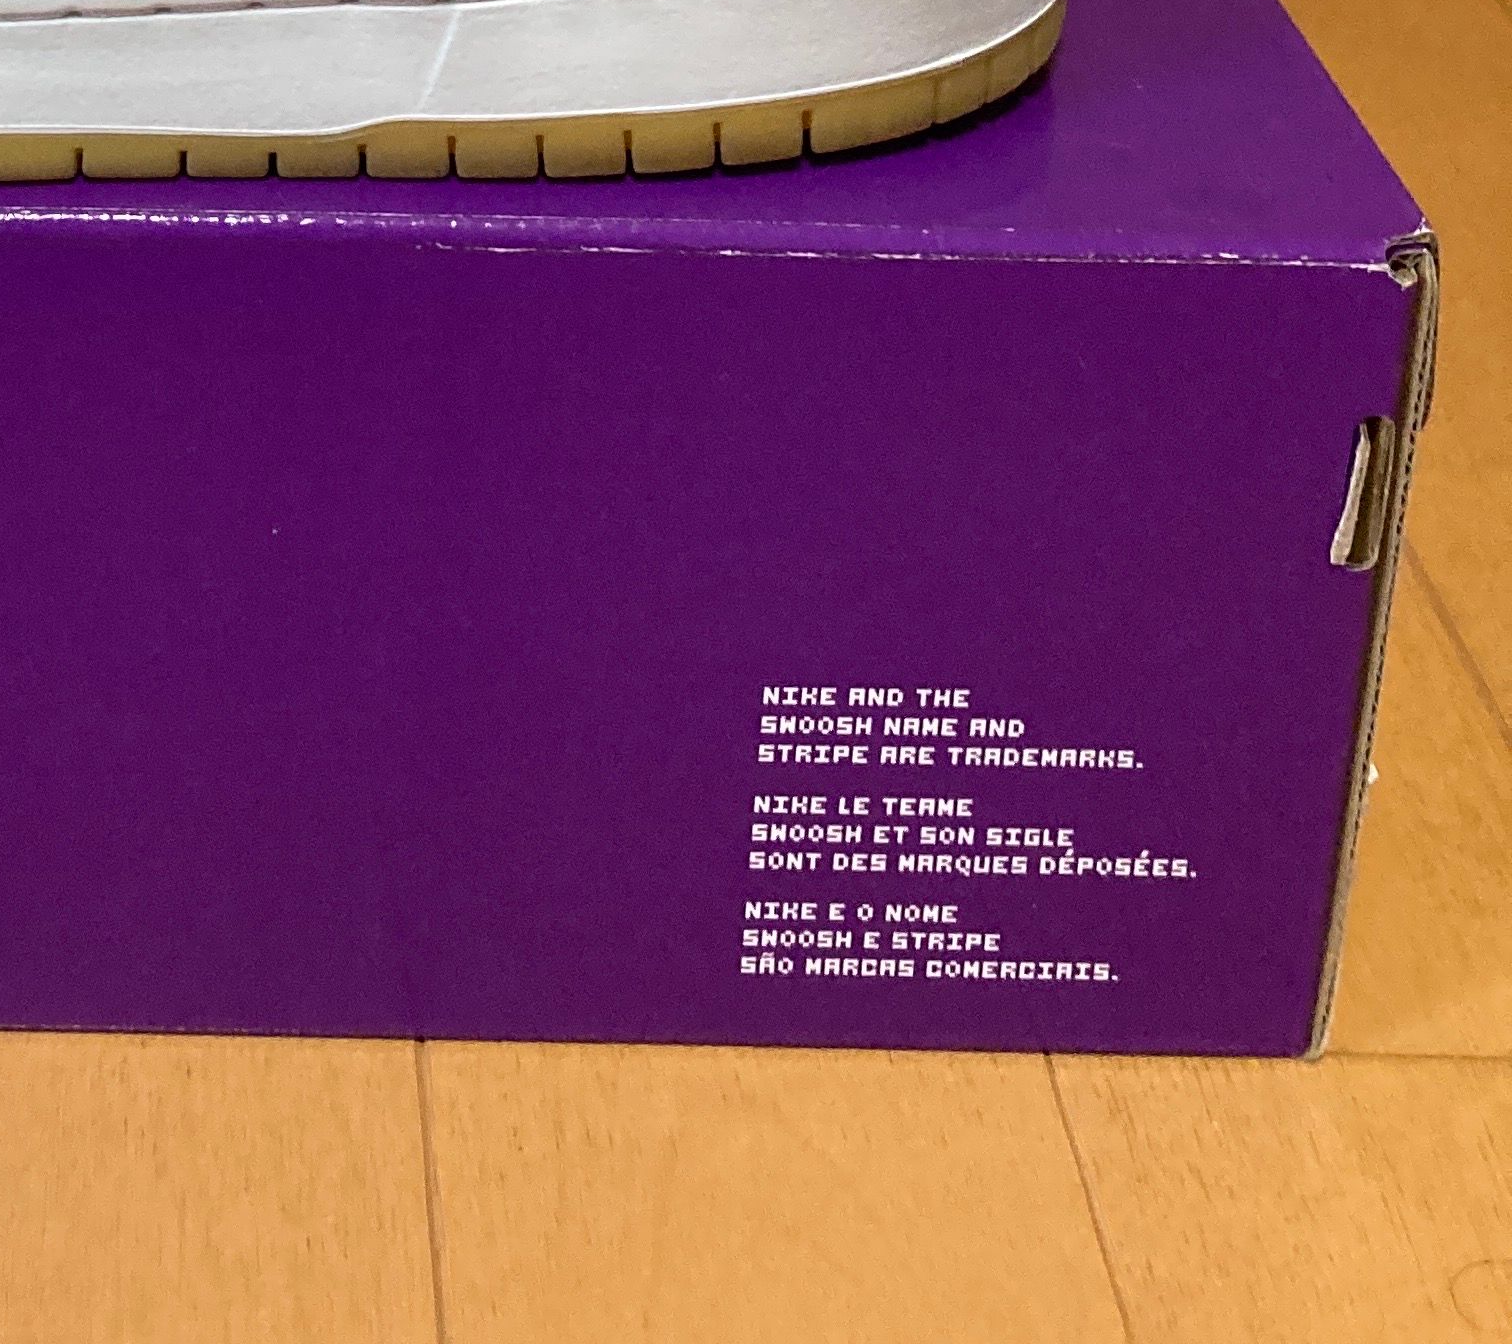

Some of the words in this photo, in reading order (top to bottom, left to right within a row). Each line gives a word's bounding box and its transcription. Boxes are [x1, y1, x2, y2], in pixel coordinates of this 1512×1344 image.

[762, 686, 837, 706] NIKE
[848, 687, 904, 707] AND
[916, 688, 970, 708] THE
[760, 715, 873, 736] SWOOSH
[883, 717, 959, 737] NAME
[969, 718, 1025, 738] AND
[757, 743, 869, 764] STRIPE
[880, 745, 936, 765] ARE
[947, 747, 1144, 769] TRADEMARKS.
[753, 795, 828, 815] NIKE
[838, 796, 871, 816] LE
[751, 823, 863, 844] SWOOSH
[873, 825, 909, 845] ET
[919, 826, 975, 846] SON
[985, 827, 1074, 848] SIGLE
[749, 851, 822, 872] SONT
[832, 852, 888, 872] DES
[898, 854, 1028, 877] MARQUES
[1039, 848, 1197, 878] DÉPOSÉES.
[744, 901, 818, 921] NIKE
[828, 902, 846, 921] E
[857, 903, 874, 922] O
[885, 904, 959, 924] NOME
[742, 929, 852, 949] SWOOSH
[863, 931, 881, 950] E
[891, 931, 1001, 952] STRIPE
[740, 951, 794, 975] SÃO
[805, 957, 915, 978] MARCAS
[925, 959, 1119, 981] COMERCIAIS.
